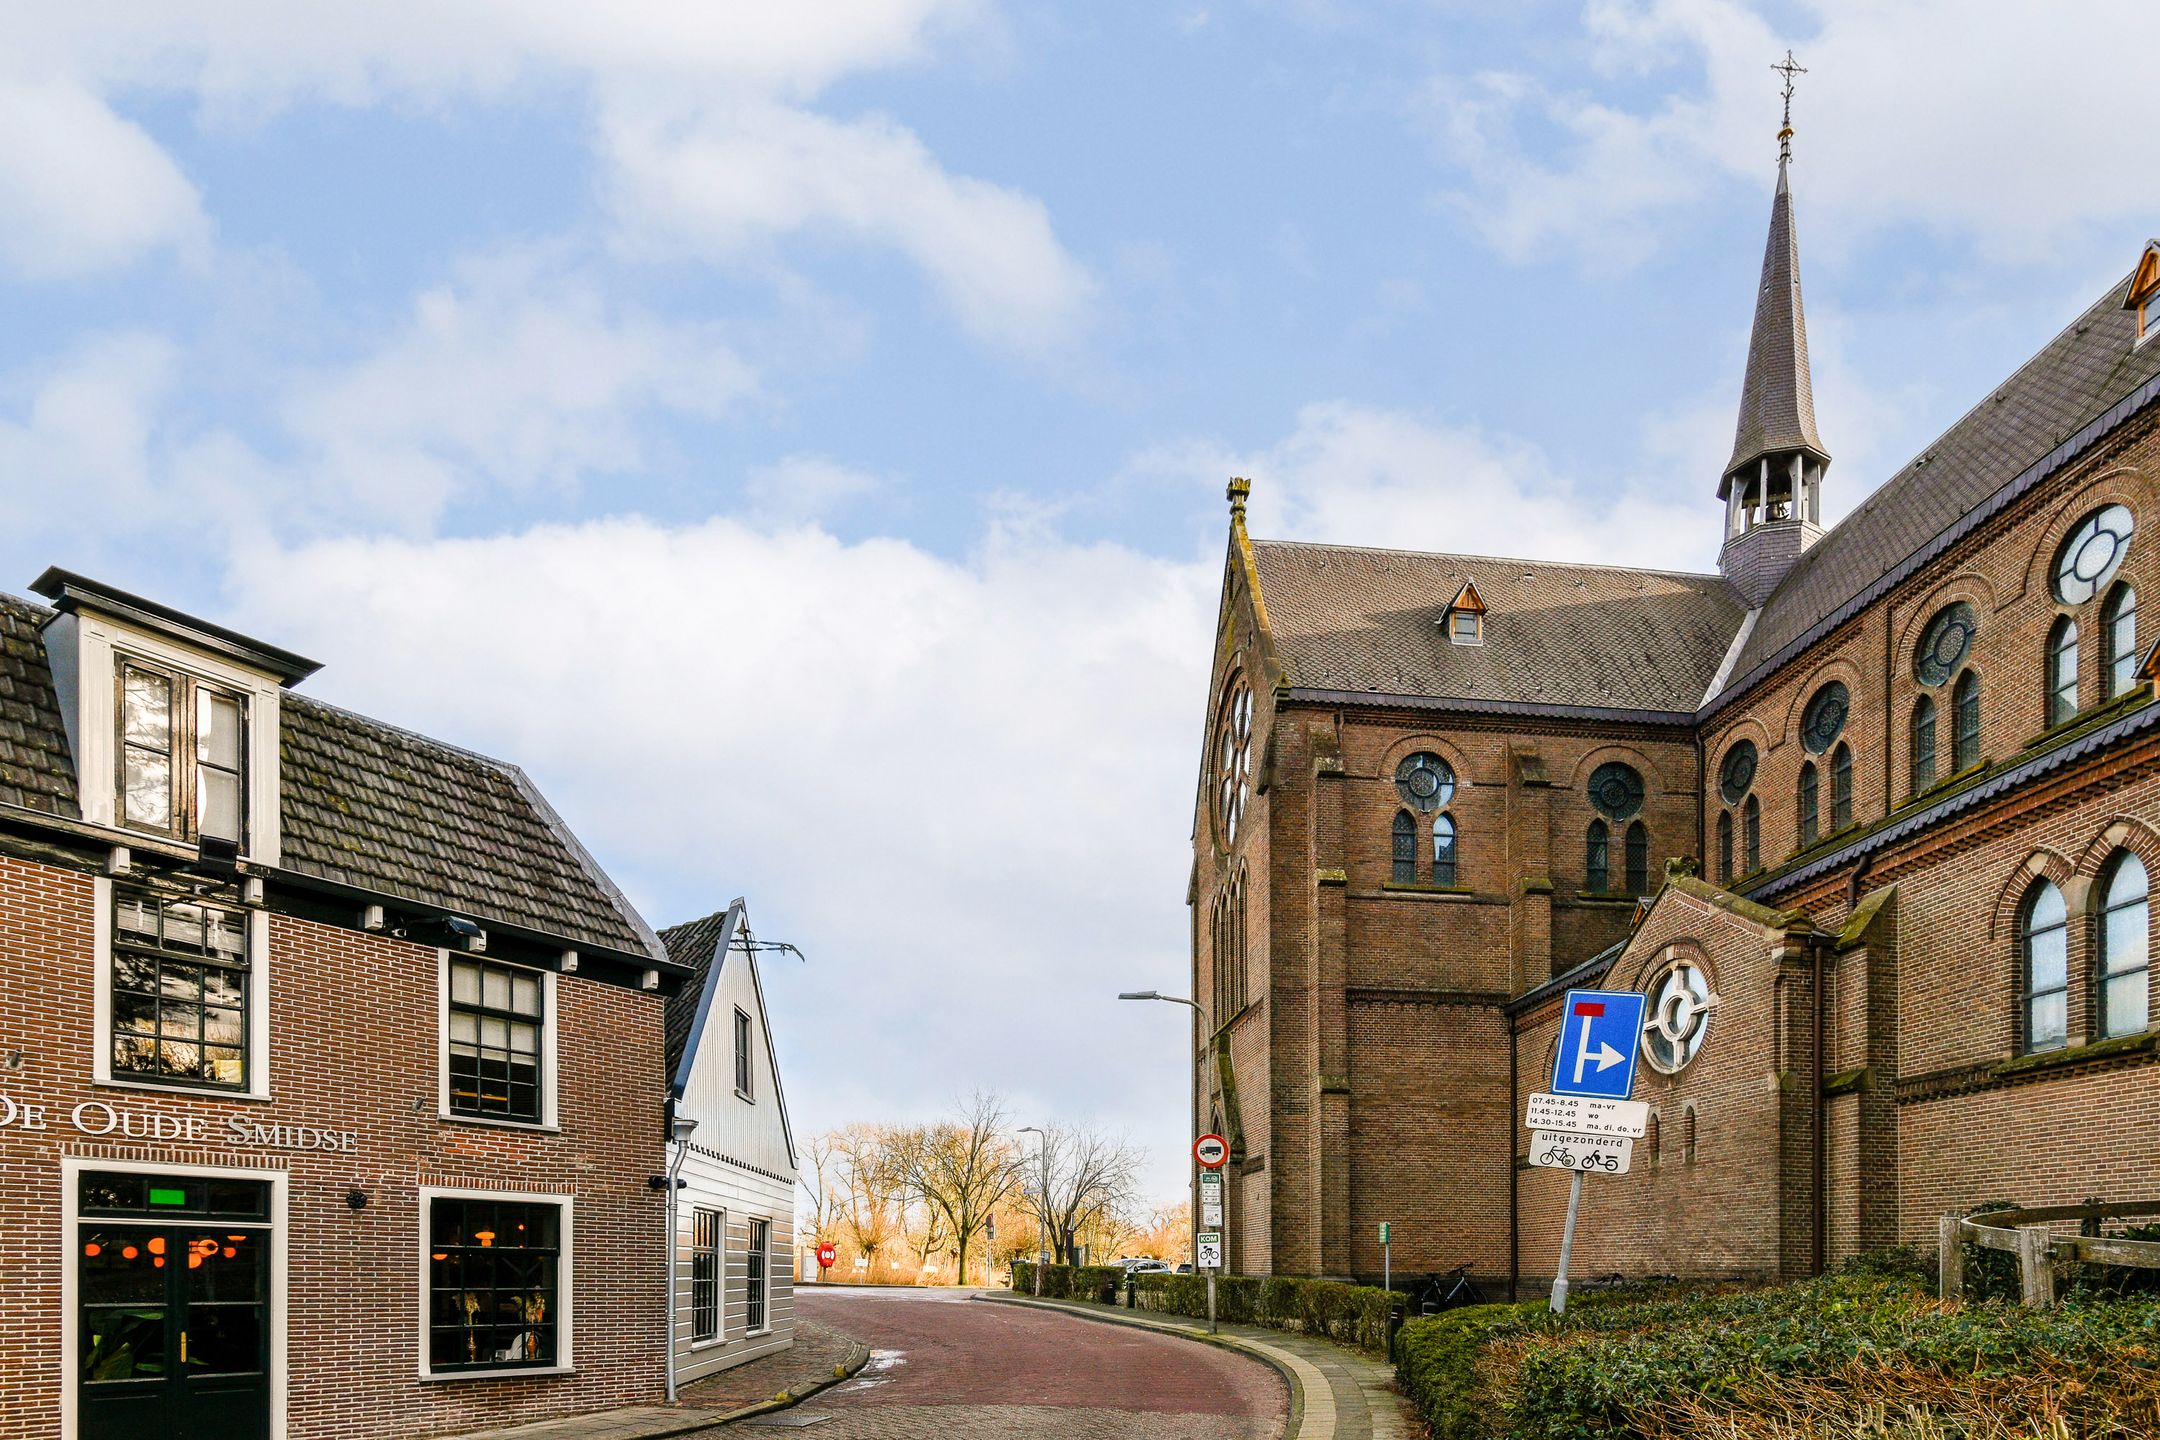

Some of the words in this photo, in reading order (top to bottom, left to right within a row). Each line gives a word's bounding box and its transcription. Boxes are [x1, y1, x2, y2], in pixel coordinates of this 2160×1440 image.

[1532, 1097, 1579, 1107] 07.45-8.45
[1531, 1107, 1577, 1117] 11.45-12.45
[72, 1102, 207, 1142] OUDE
[227, 1113, 358, 1153] SMIDSE
[1529, 1118, 1577, 1128] 14.30-15.45
[1541, 1133, 1623, 1147] uitgezonderd
